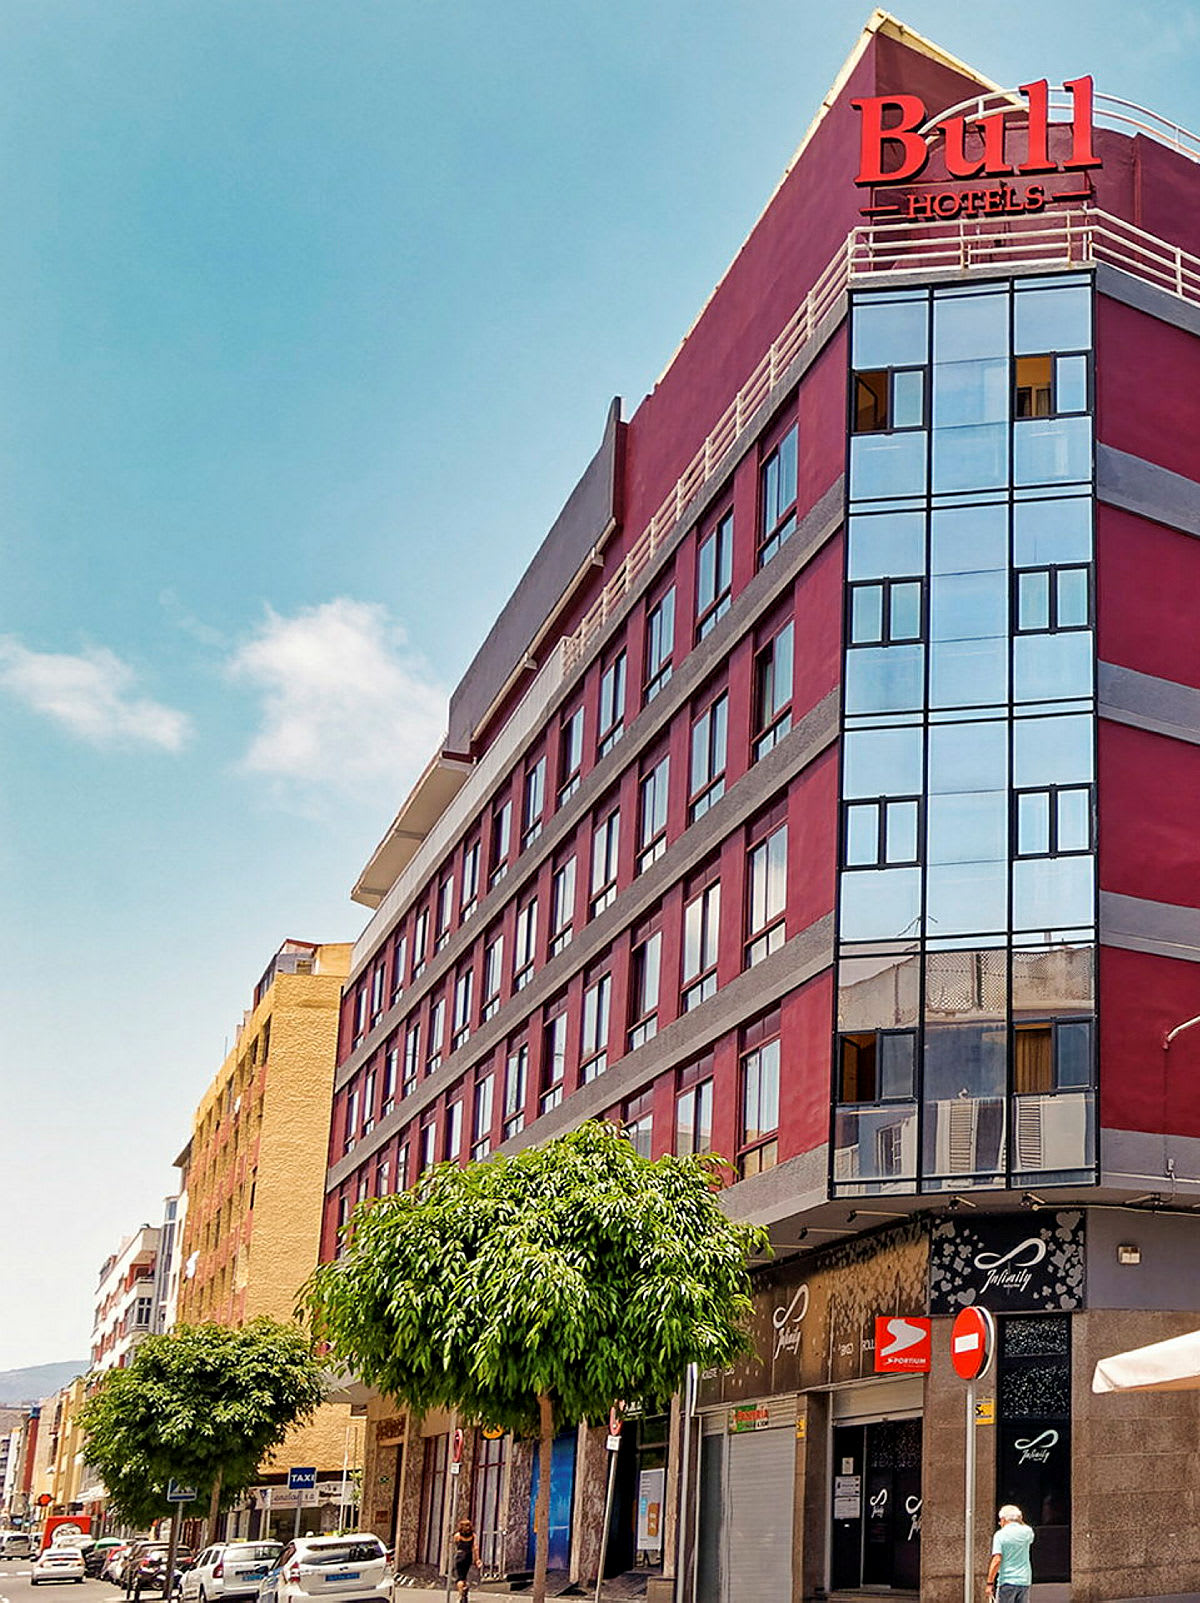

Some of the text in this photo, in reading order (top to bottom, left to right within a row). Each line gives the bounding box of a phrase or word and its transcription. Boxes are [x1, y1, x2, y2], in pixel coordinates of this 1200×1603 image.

[852, 75, 1102, 187] Bull
[905, 185, 1045, 219] HOTELS
[980, 1268, 1033, 1294] Infinity
[291, 1474, 315, 1483] TAXI
